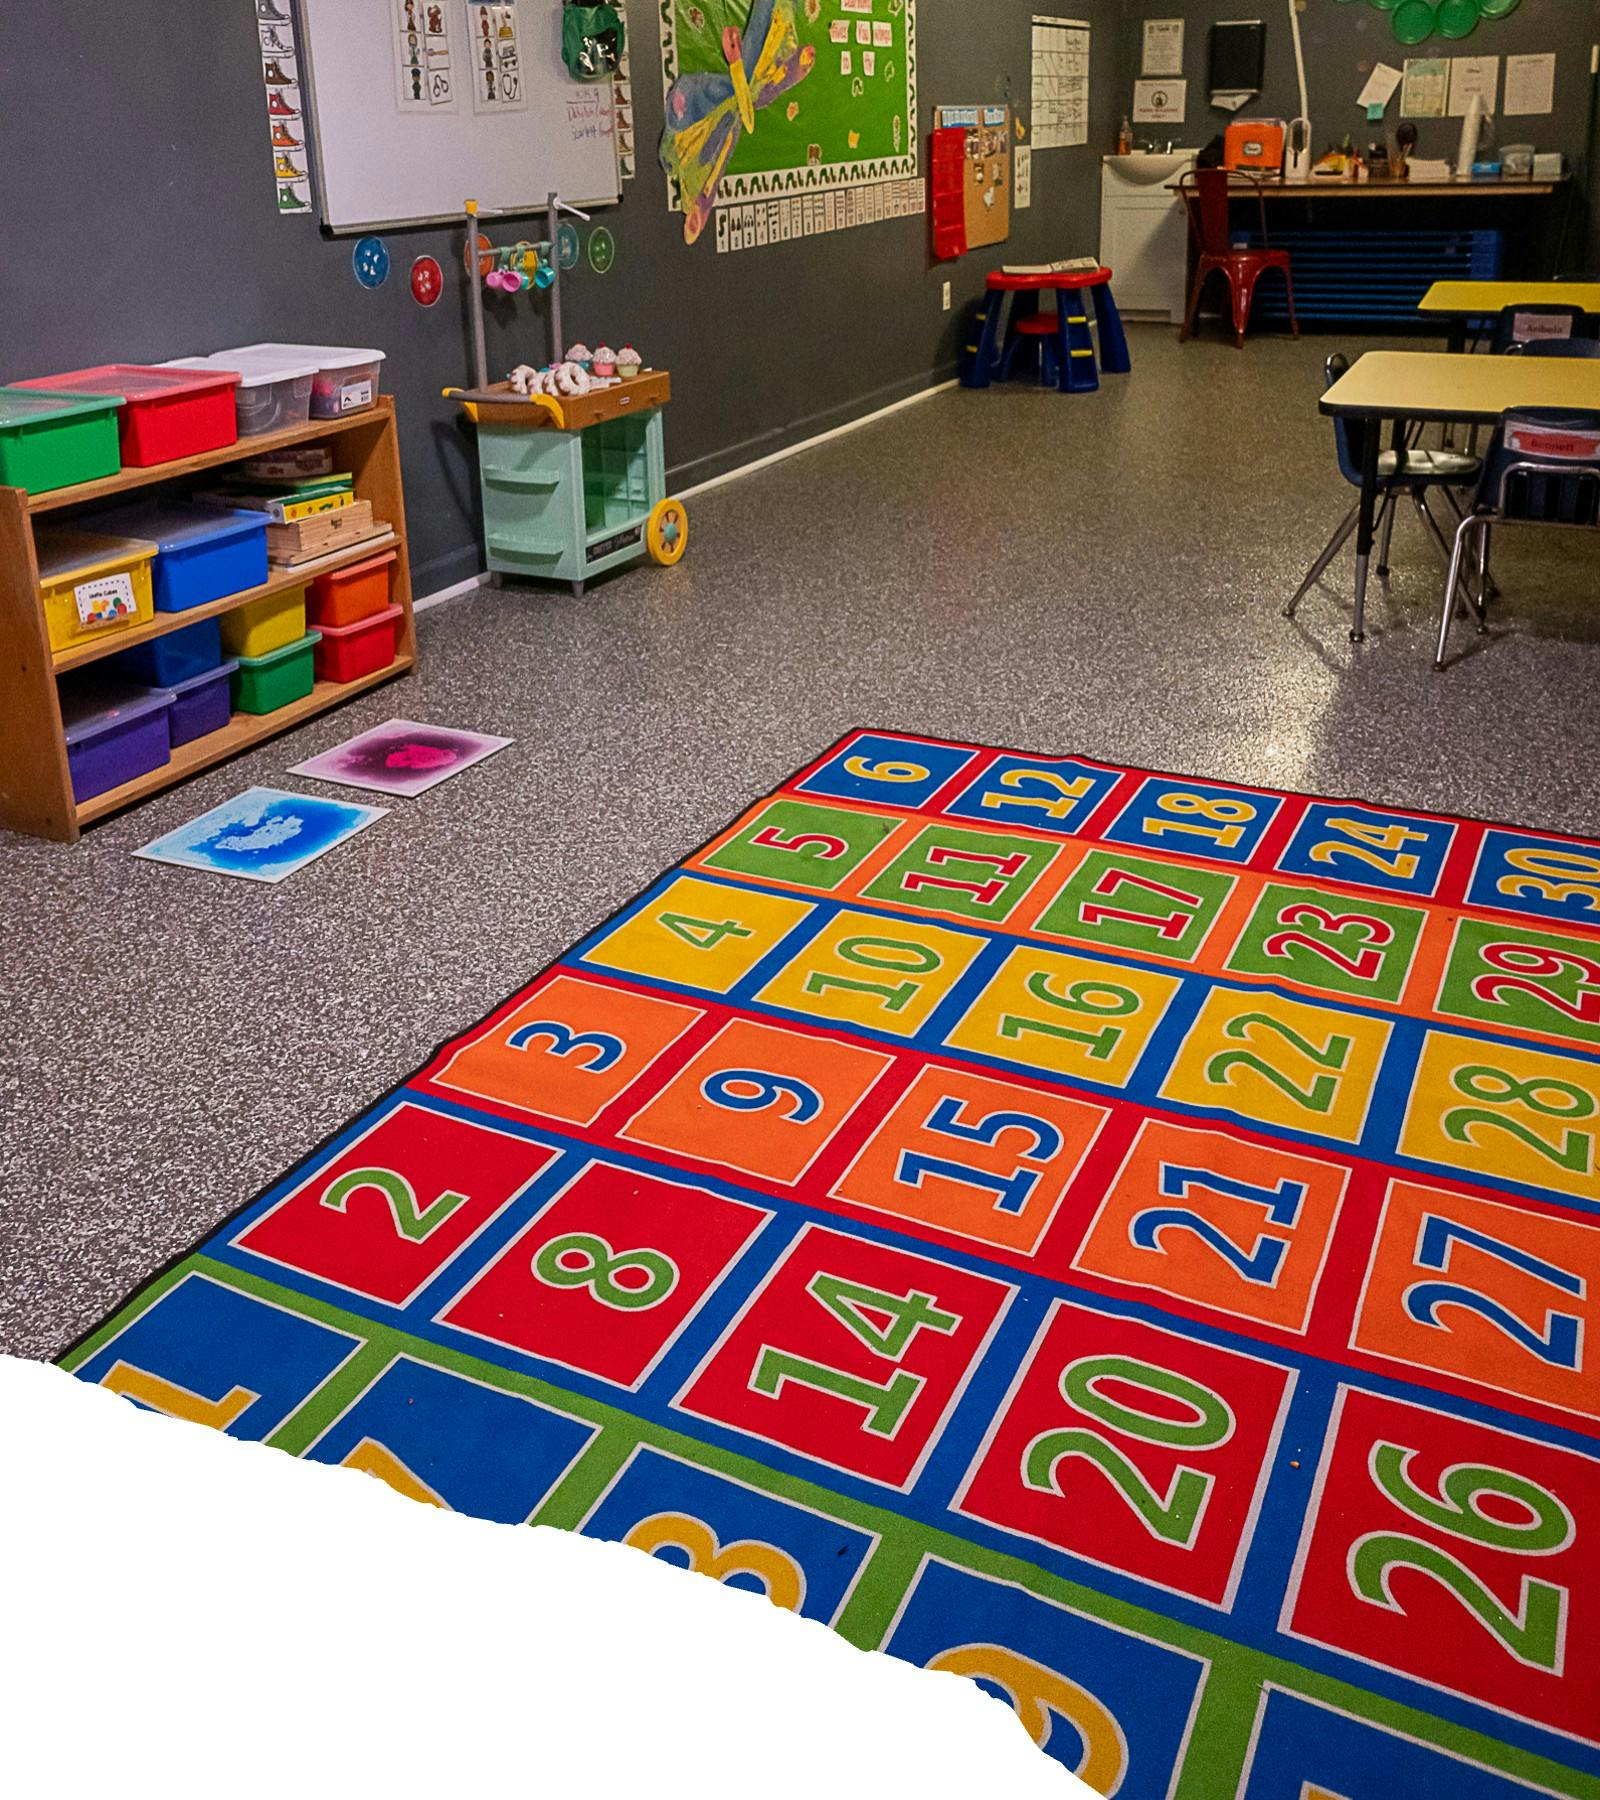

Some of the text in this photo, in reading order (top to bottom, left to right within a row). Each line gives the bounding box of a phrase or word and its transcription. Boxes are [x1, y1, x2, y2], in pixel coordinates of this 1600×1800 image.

[843, 755, 930, 783] 6
[982, 769, 1096, 819] 12
[748, 826, 849, 860] 5
[1142, 793, 1257, 848] 18
[1308, 816, 1428, 879] 24
[901, 846, 1031, 906] 11
[1079, 868, 1203, 941] 17
[1496, 848, 1600, 910] 30
[657, 911, 756, 950] 4
[1263, 903, 1395, 981] 23
[803, 935, 944, 1014] 10
[1470, 942, 1600, 1025] 29
[505, 1020, 628, 1074] 3
[999, 970, 1142, 1061] 16
[699, 1068, 825, 1125] 9
[1205, 1011, 1355, 1114] 22
[894, 1096, 1065, 1216] 15
[1440, 1063, 1599, 1176] 28
[319, 1166, 472, 1245] 2
[1127, 1161, 1310, 1289] 21
[530, 1231, 680, 1312] 8
[1401, 1211, 1587, 1372] 27
[747, 1270, 963, 1441] 14
[1020, 1353, 1237, 1551] 20
[1345, 1439, 1577, 1678] 26
